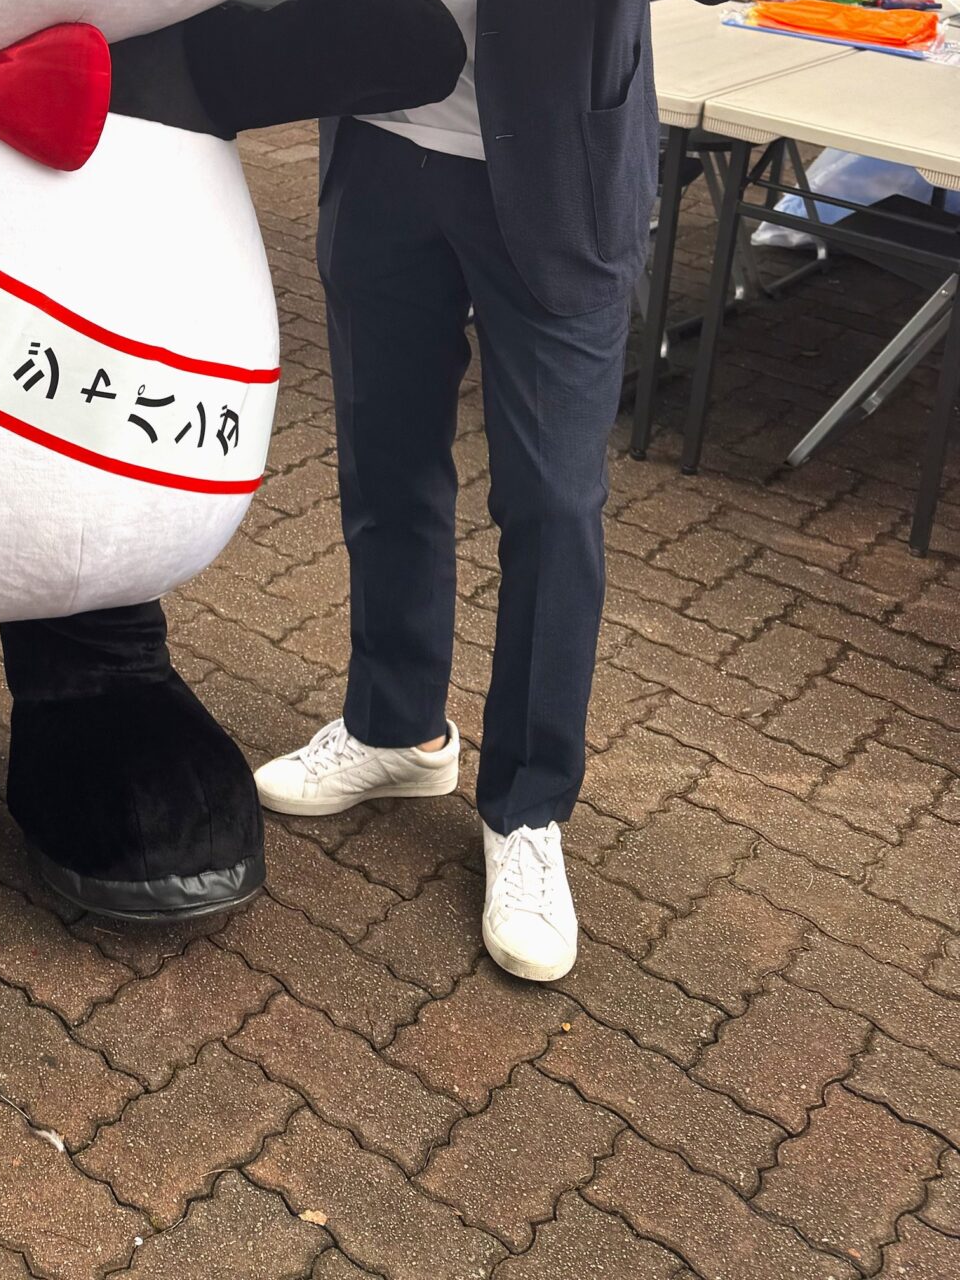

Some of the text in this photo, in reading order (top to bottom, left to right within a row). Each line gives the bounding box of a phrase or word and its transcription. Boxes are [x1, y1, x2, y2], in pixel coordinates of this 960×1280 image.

[13, 342, 240, 456] ジャパンダ
